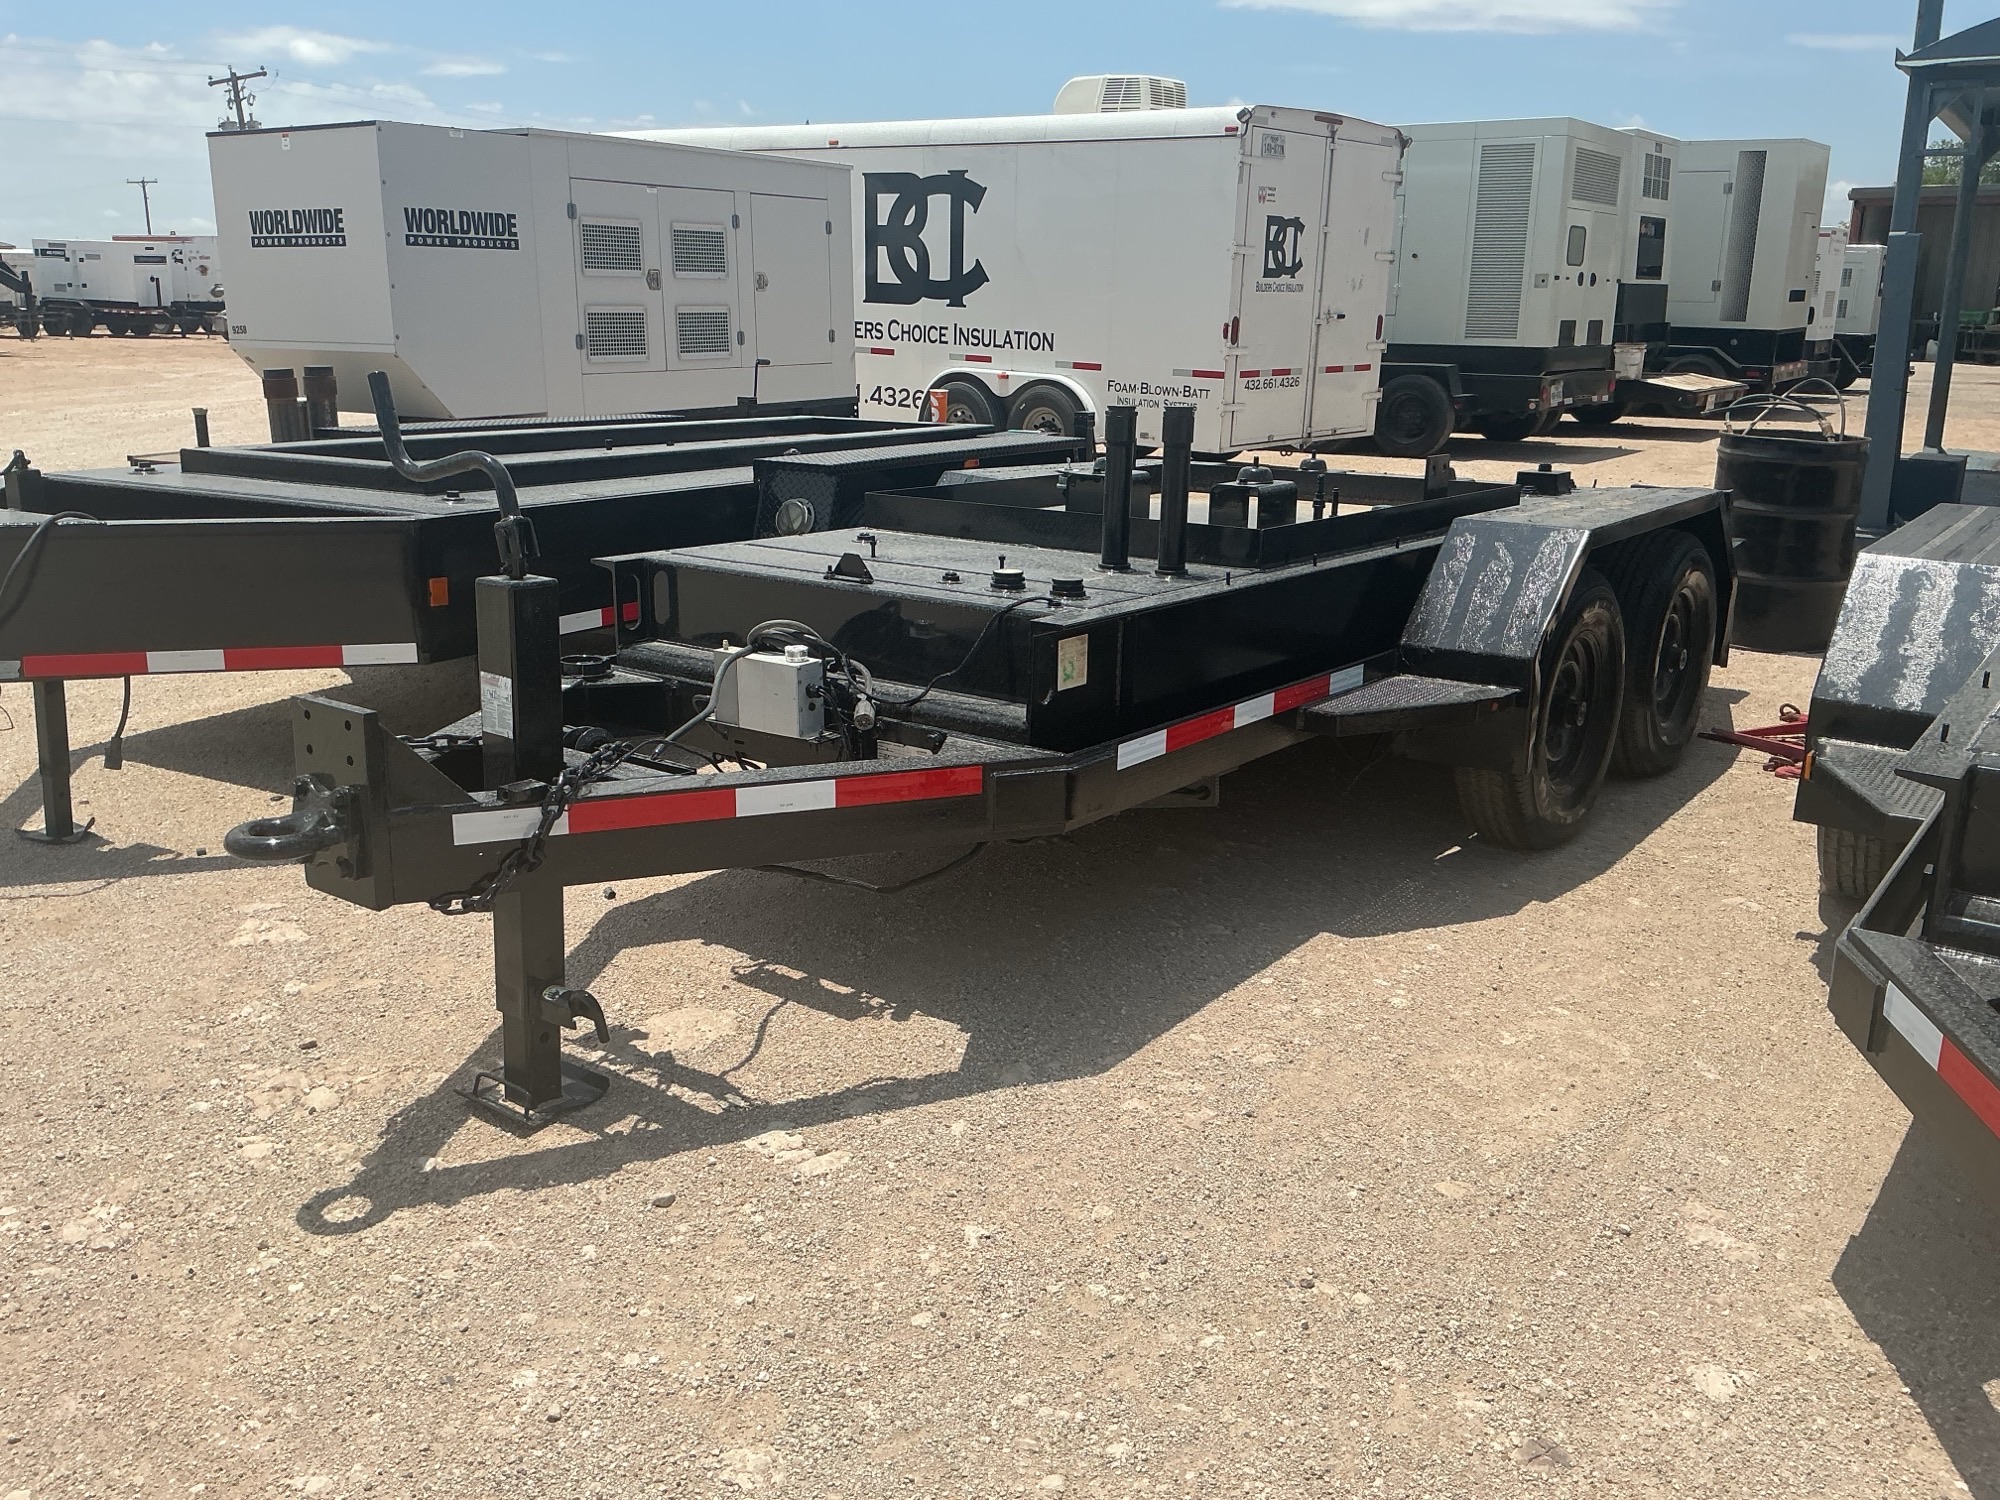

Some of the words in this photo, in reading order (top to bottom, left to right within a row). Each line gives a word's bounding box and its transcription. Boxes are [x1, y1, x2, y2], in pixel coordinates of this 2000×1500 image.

[249, 208, 345, 235] WORLDWIDE
[403, 207, 518, 237] WORLDWIDE
[254, 238, 286, 246] POWER
[291, 237, 344, 245] PRODUCTS
[409, 236, 449, 246] POWER
[456, 238, 516, 248] PRODUCTS
[887, 319, 949, 345] CHOICE
[953, 322, 1055, 352] INSULATION
[1244, 376, 1300, 390] 432.661.4326
[1116, 395, 1160, 409] INSULATION
